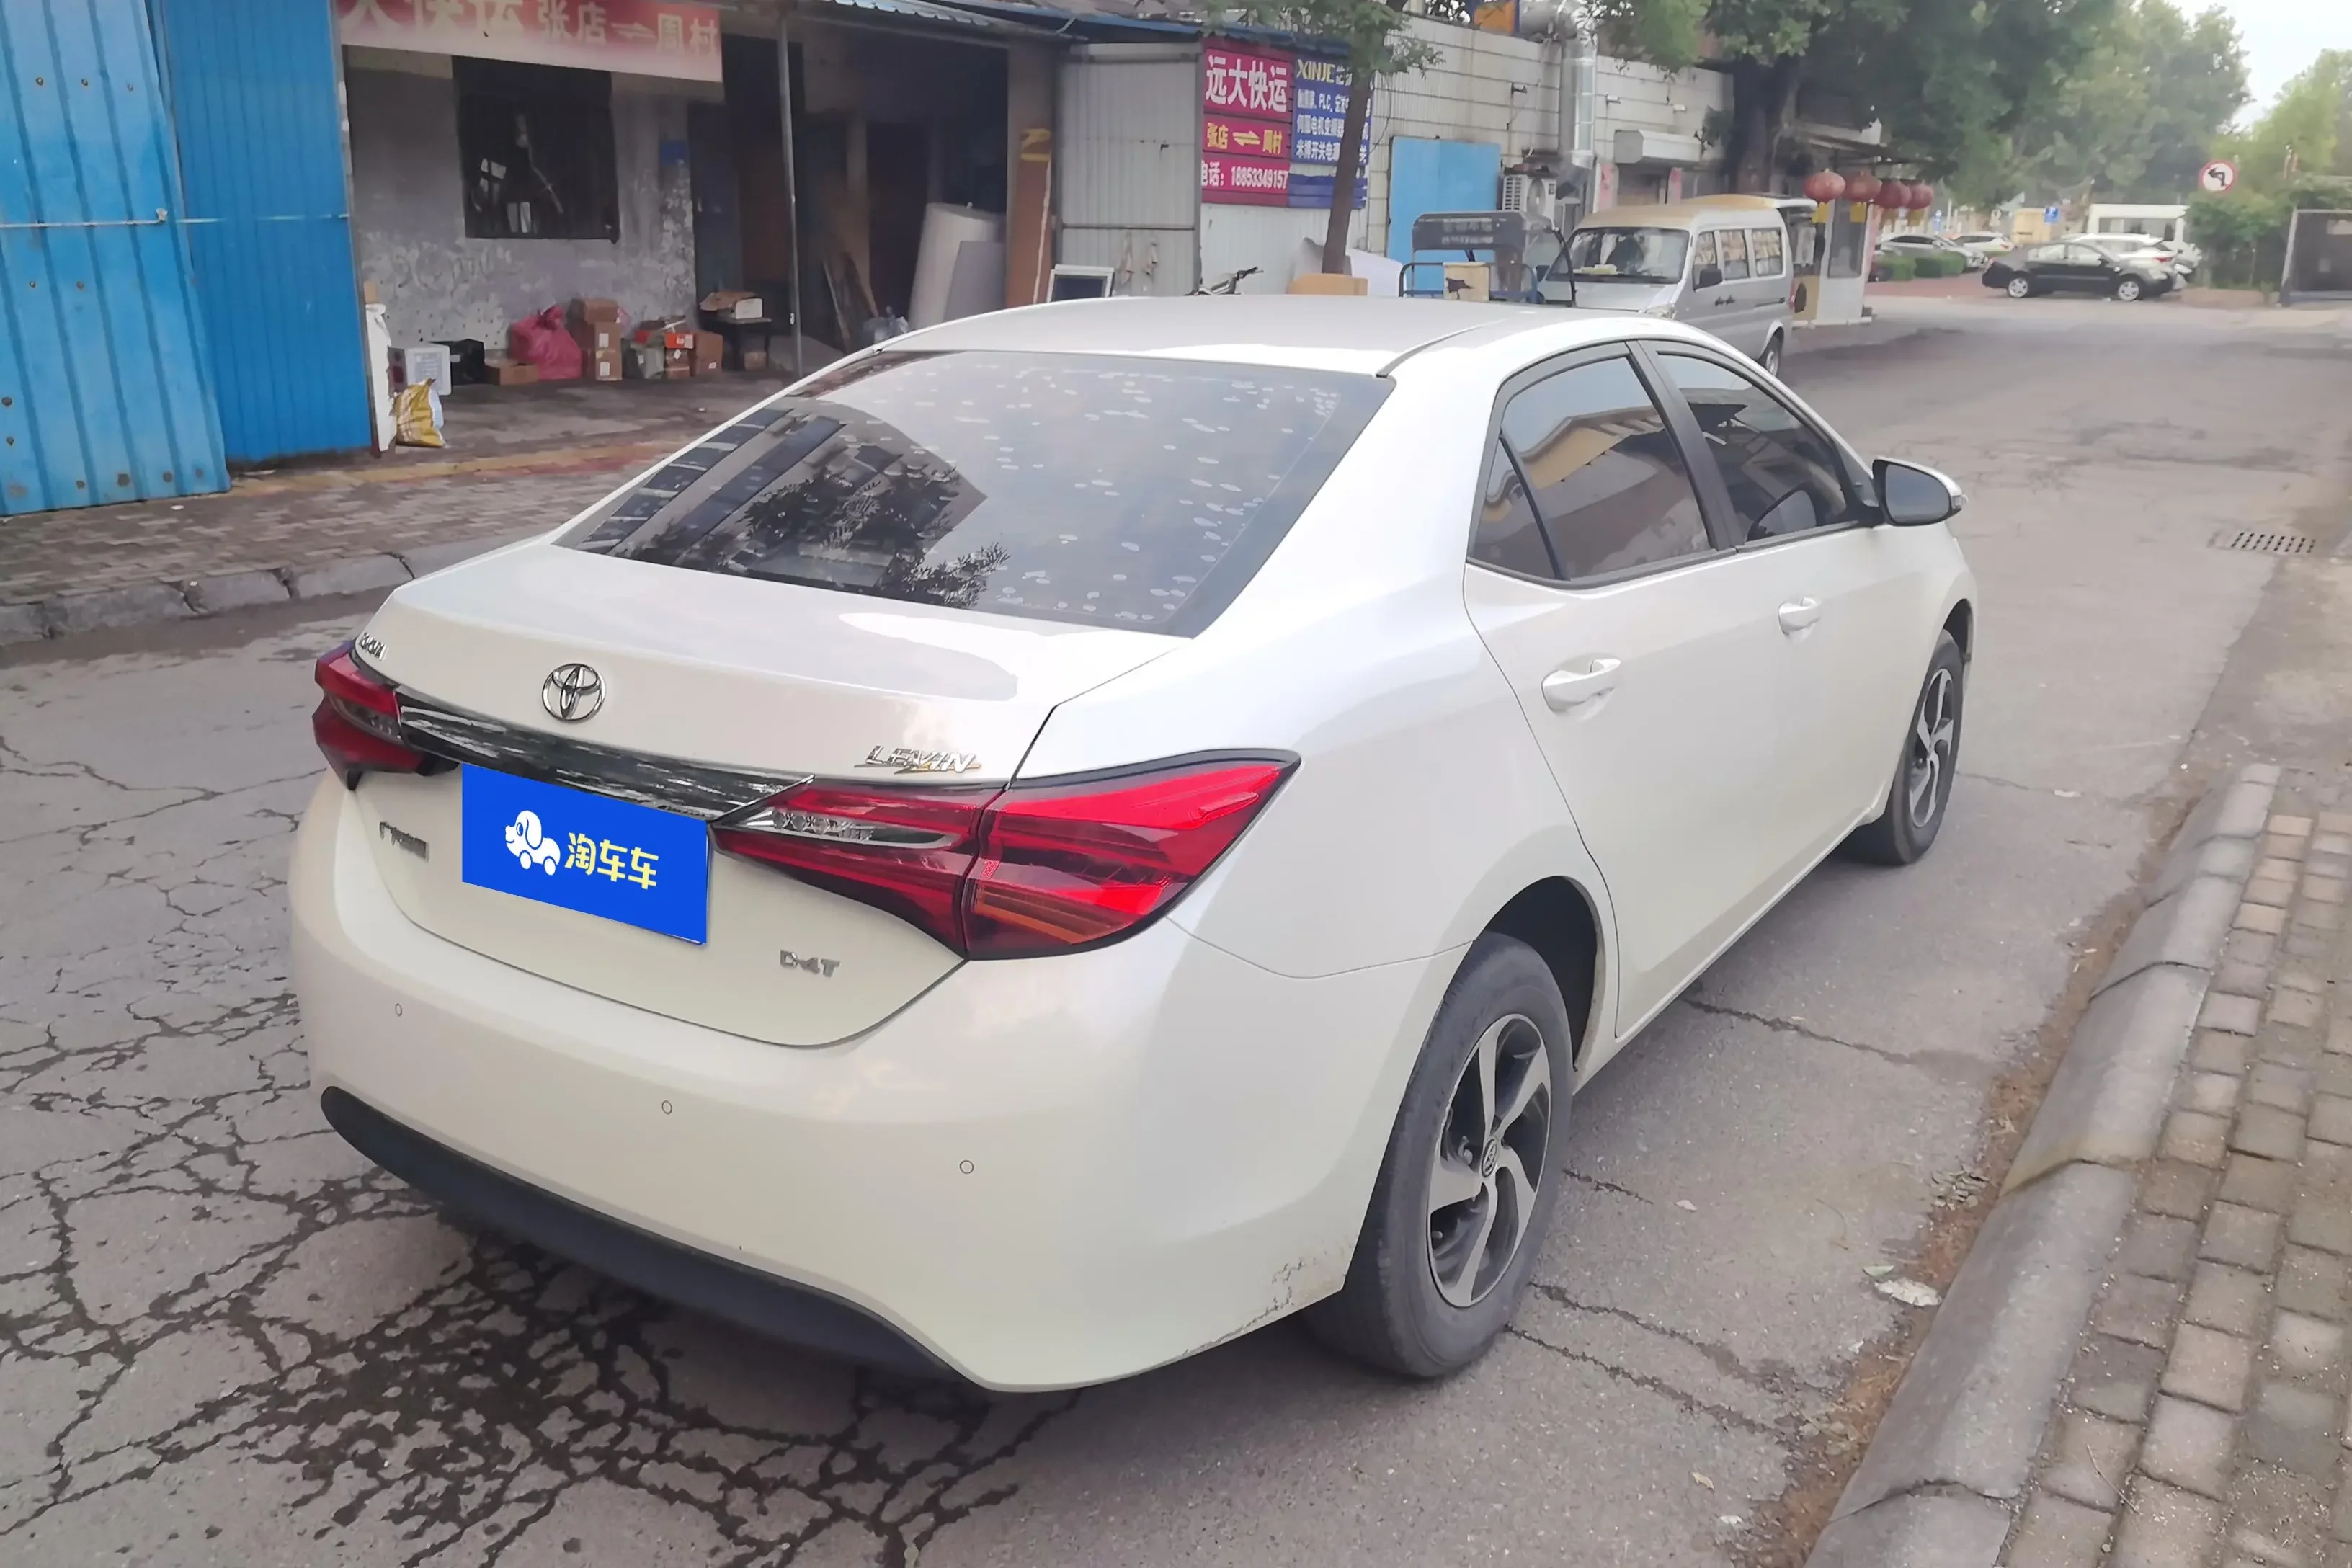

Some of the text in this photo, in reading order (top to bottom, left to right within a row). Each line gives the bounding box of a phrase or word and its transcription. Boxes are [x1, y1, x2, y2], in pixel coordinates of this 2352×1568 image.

[1206, 54, 1288, 112] 远大快运
[1296, 58, 1335, 84] XINJE
[865, 744, 978, 774] LEVIN
